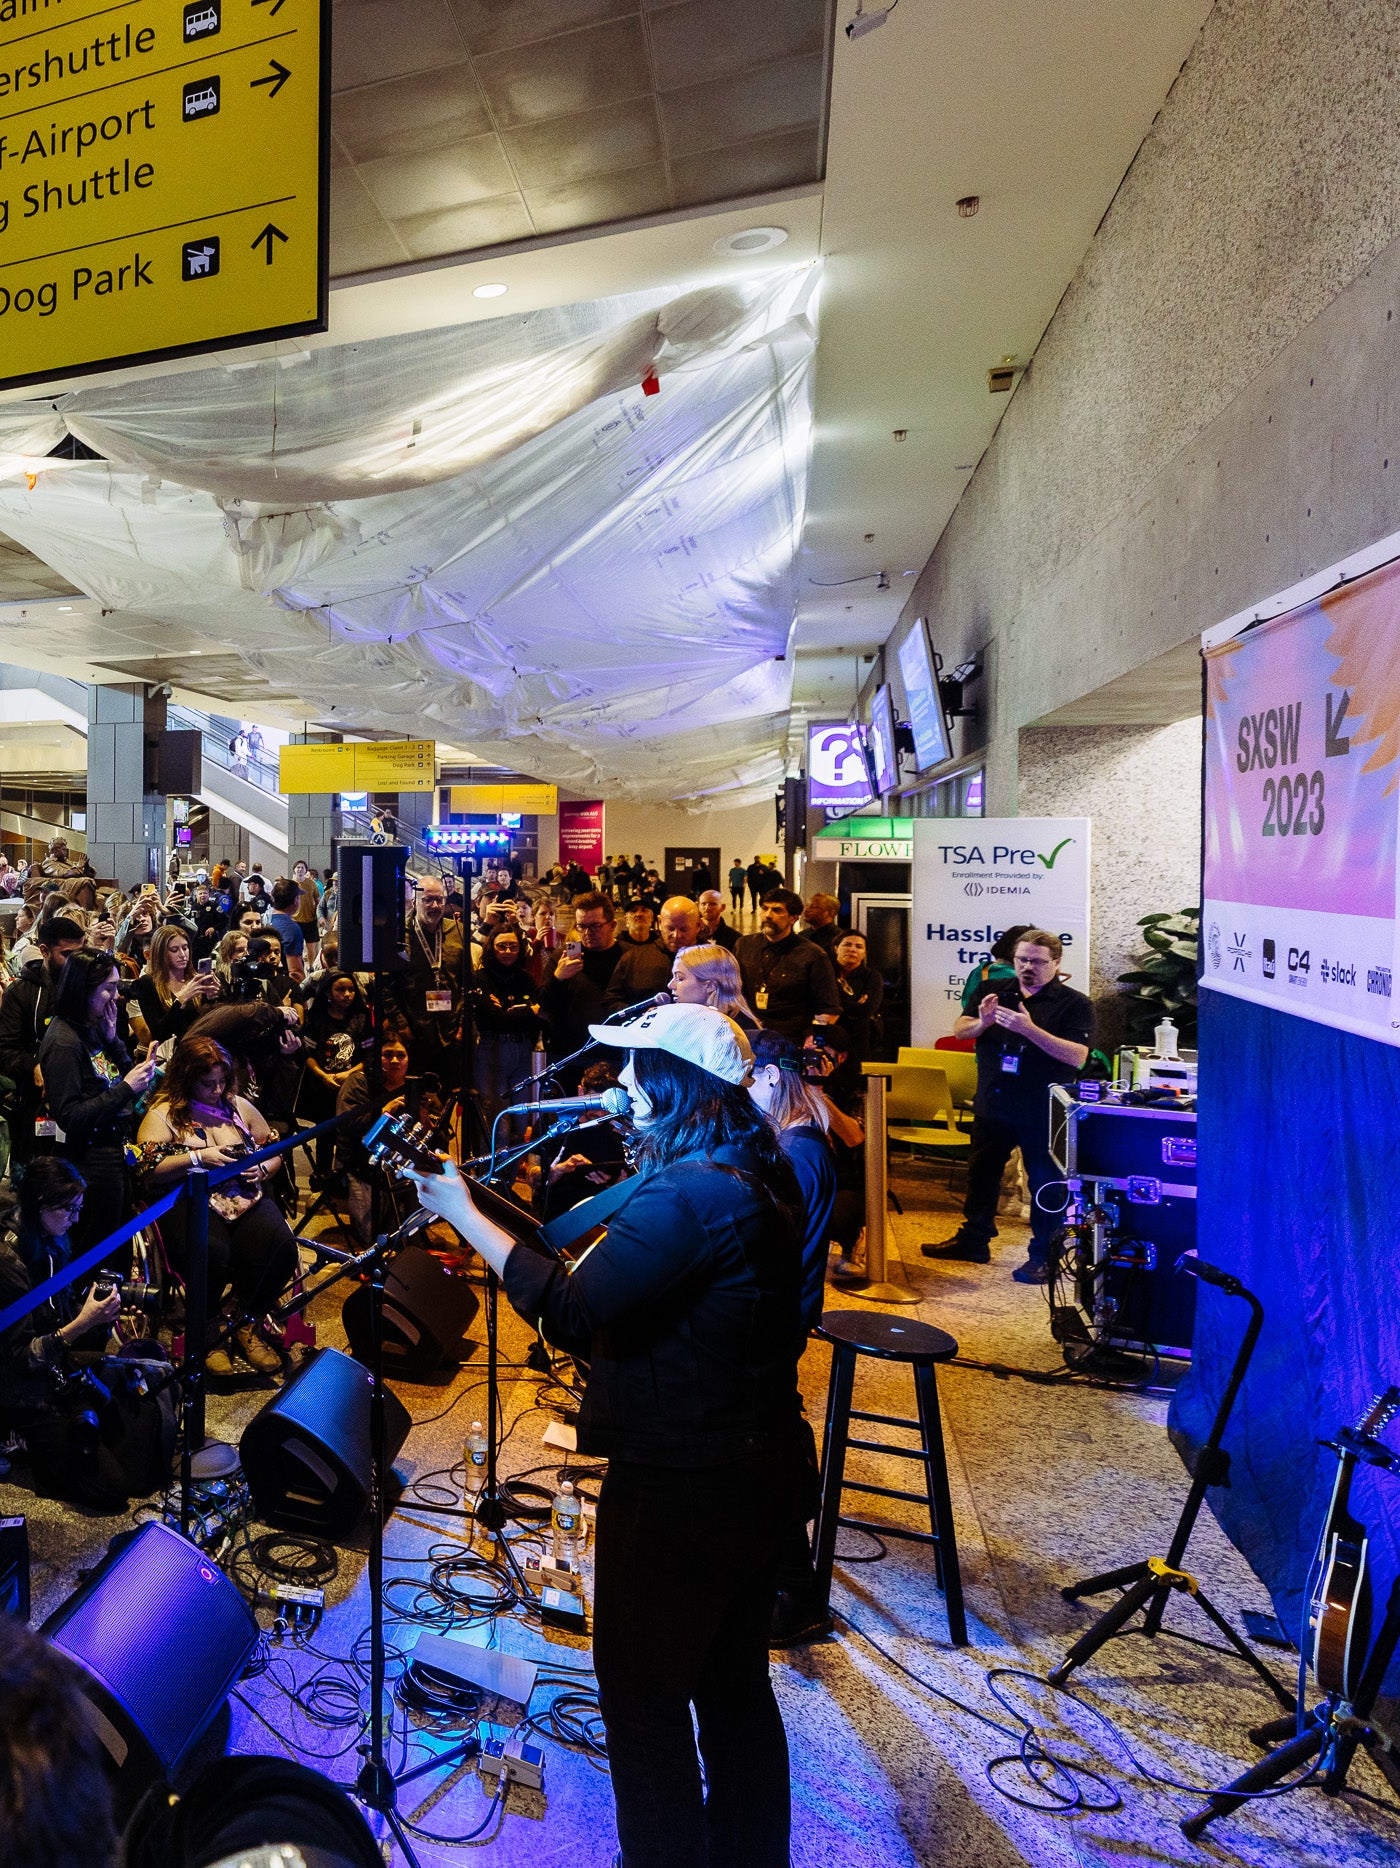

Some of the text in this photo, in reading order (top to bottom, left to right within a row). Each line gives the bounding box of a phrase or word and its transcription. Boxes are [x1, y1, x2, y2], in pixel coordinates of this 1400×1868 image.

[23, 158, 154, 218] Shuttle
[73, 253, 153, 301] Park
[1237, 701, 1302, 773] SXSW
[1262, 770, 1325, 837] 2023
[938, 846, 1035, 865] TSA Pre
[952, 871, 993, 879] Enrollment
[986, 886, 1032, 894] IDEMIA
[1288, 947, 1311, 974] C4
[1331, 961, 1357, 987] slack
